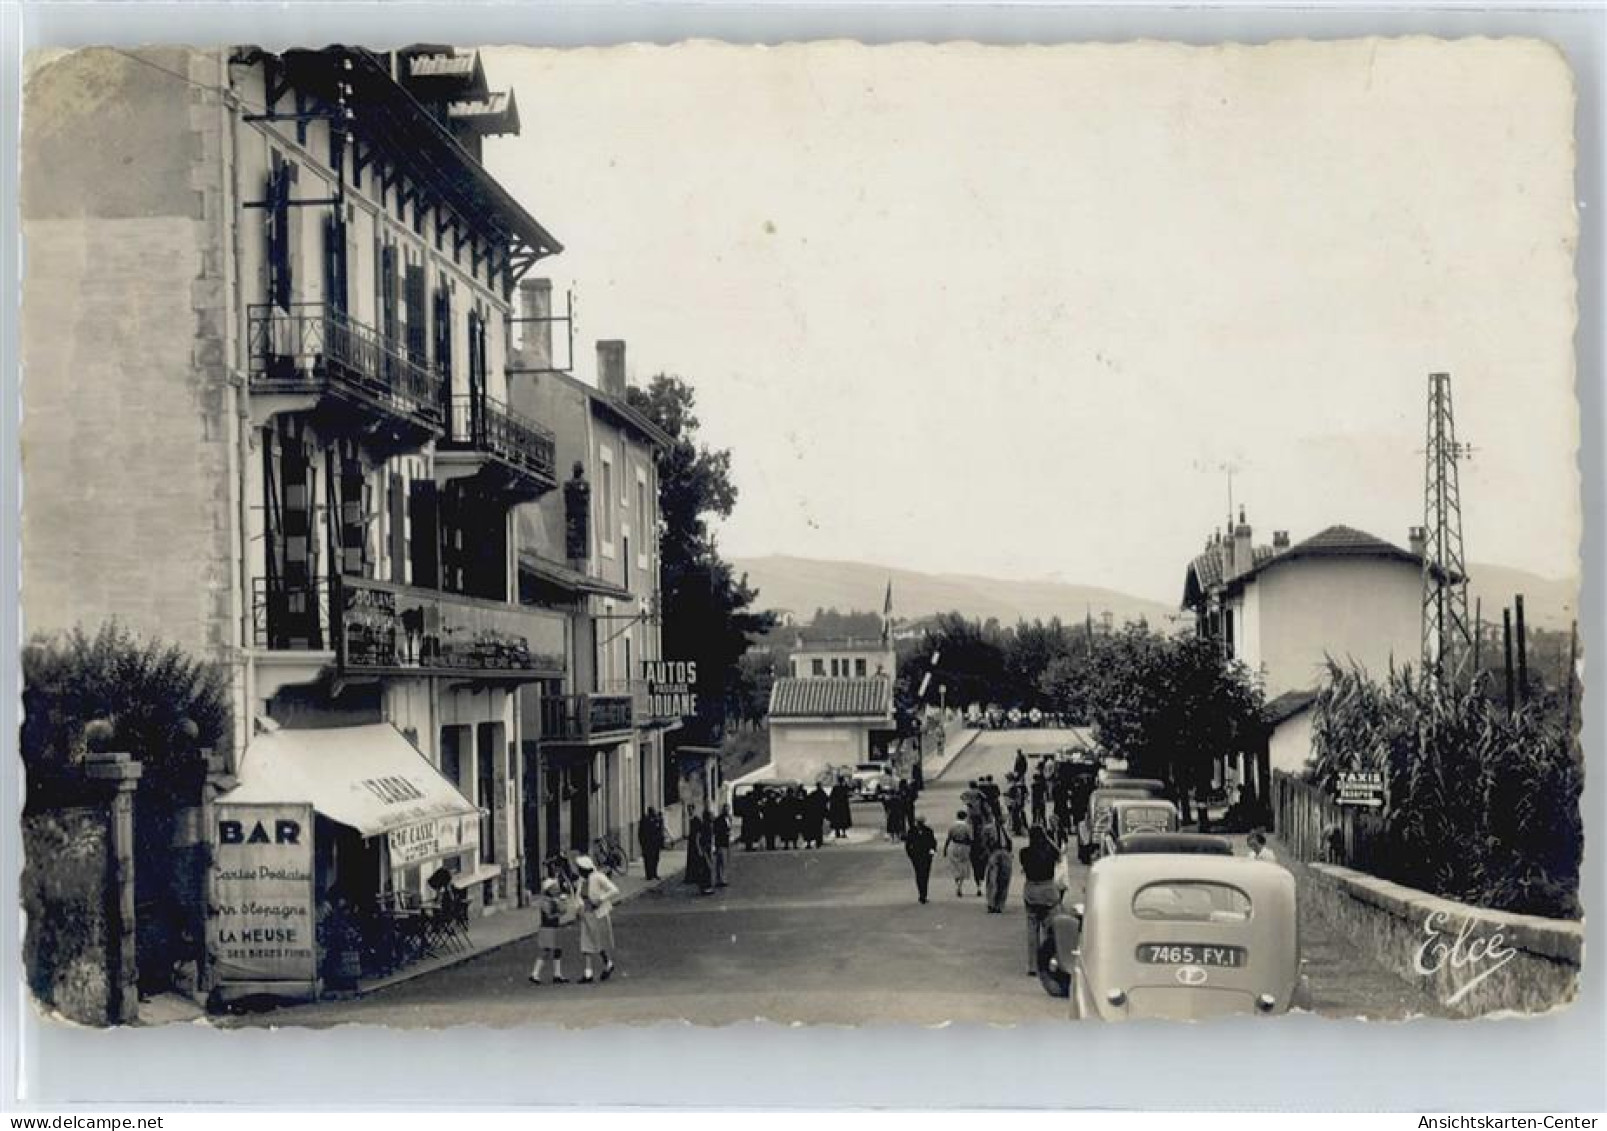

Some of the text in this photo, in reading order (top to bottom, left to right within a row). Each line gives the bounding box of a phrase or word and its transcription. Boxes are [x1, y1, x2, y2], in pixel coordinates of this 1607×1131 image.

[646, 661, 697, 685] AUTOS
[1338, 772, 1380, 783] TAXIS
[219, 820, 301, 845] BAR
[219, 929, 238, 944] LA
